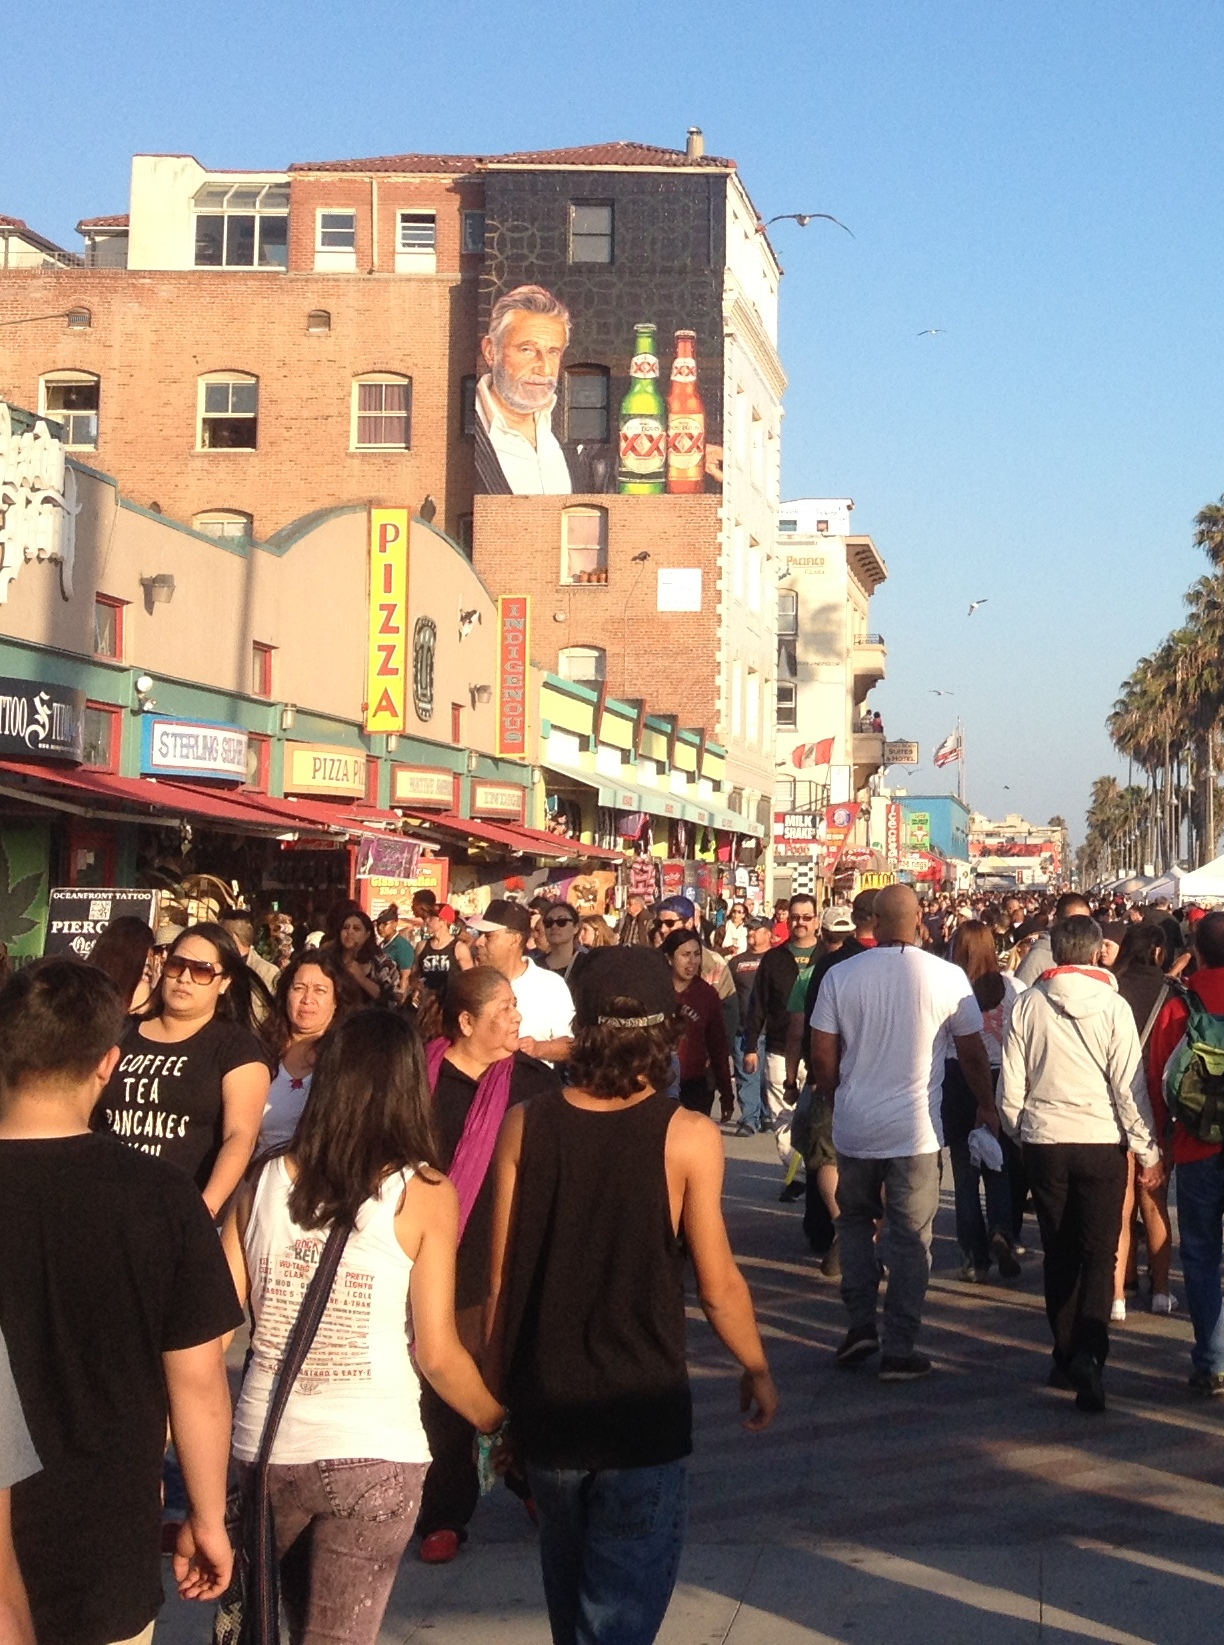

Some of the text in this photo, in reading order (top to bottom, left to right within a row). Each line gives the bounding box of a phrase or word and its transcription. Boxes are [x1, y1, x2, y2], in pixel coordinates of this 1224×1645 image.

[620, 432, 666, 457] XX
[372, 523, 400, 718] PIZZA
[503, 604, 524, 744] INDIGENOUS
[158, 731, 219, 762] STERLING
[312, 756, 349, 783] PIZZA
[783, 827, 815, 839] SHAKE
[784, 815, 813, 828] MILK
[119, 1054, 188, 1077] COFFEE
[123, 1077, 159, 1104] TEA
[344, 1280, 373, 1290] LIGHTS
[345, 1271, 375, 1282] PRETTY
